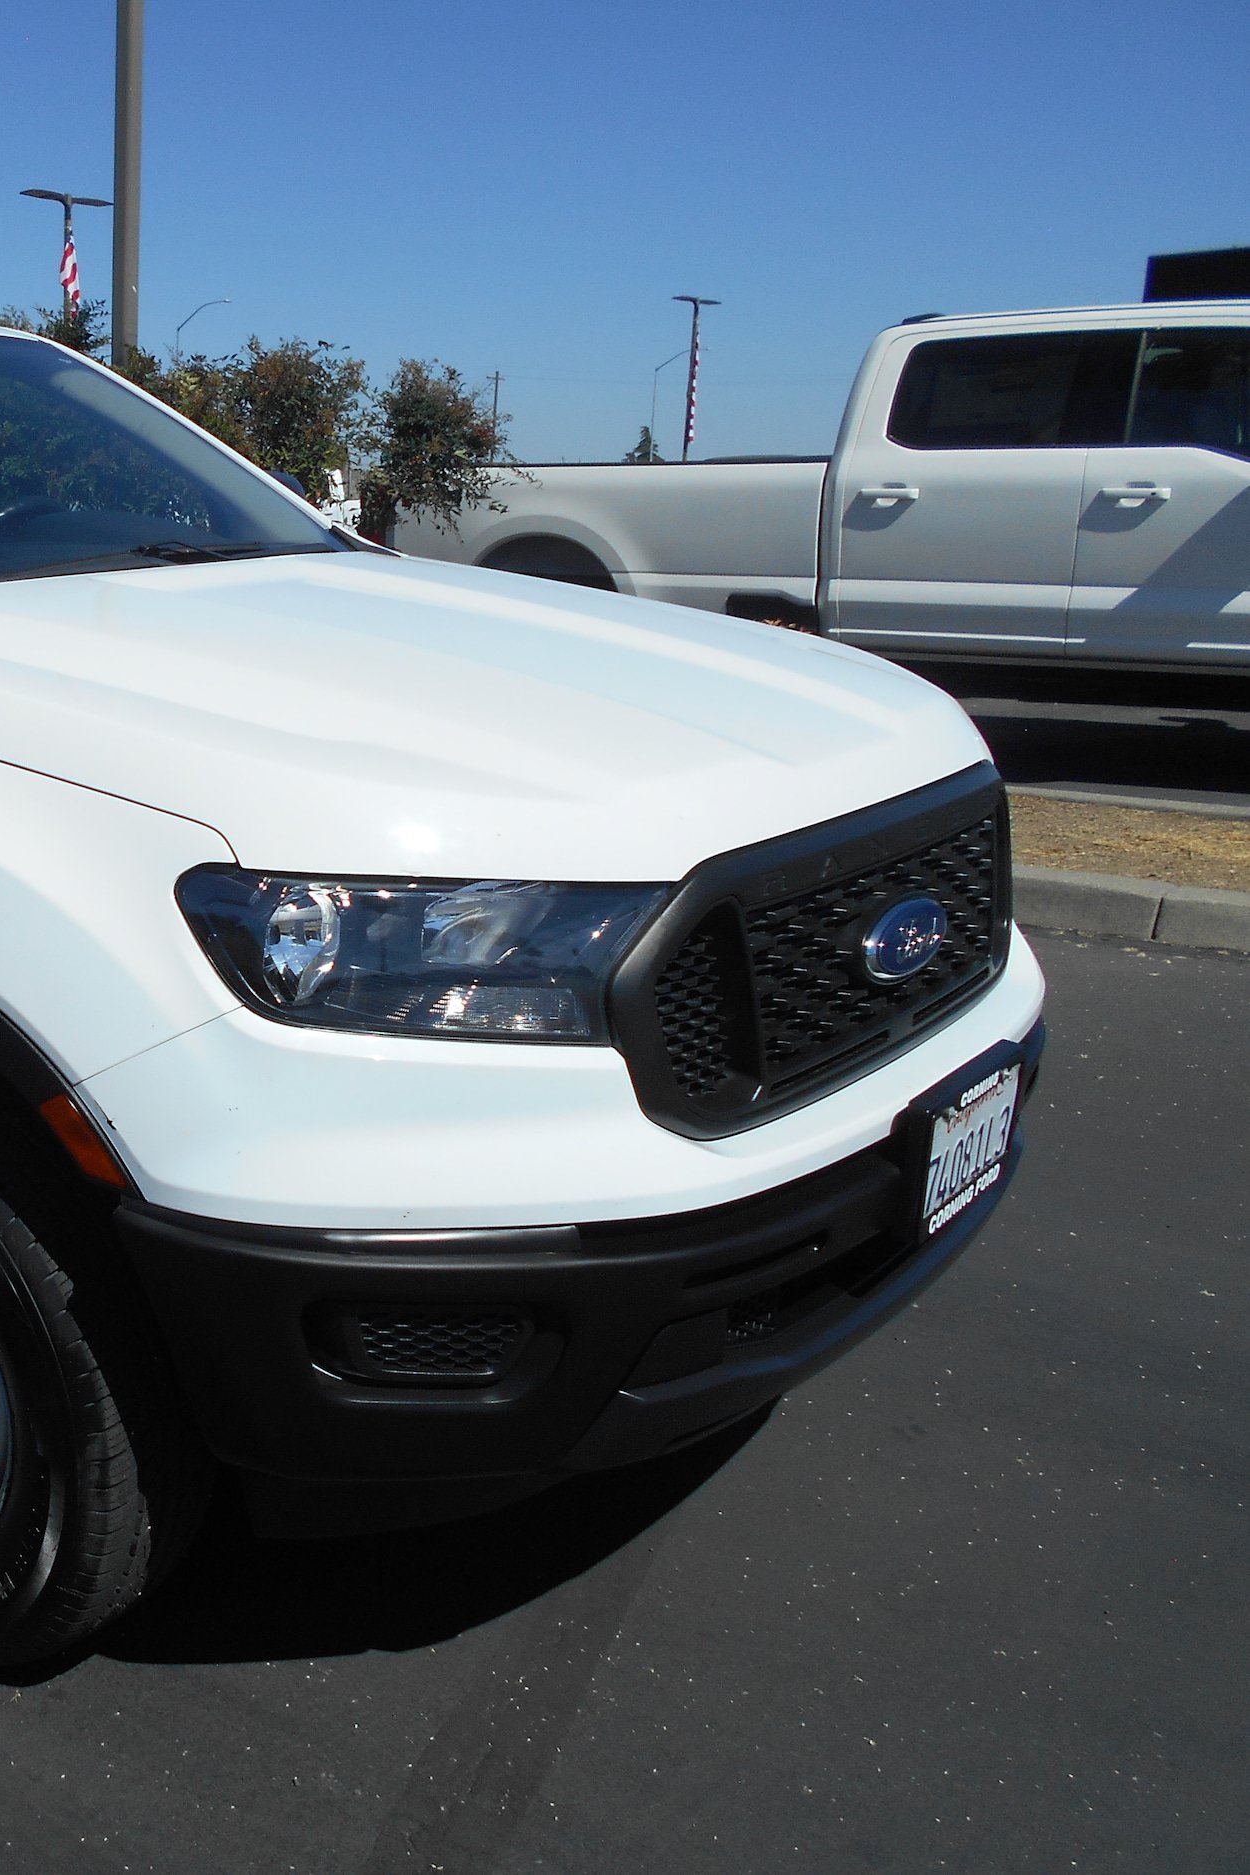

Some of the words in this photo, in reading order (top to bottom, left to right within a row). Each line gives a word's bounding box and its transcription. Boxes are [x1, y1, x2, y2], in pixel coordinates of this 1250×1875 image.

[960, 1070, 1000, 1108] CORNING
[925, 1105, 1011, 1214] 74081L3
[928, 1184, 975, 1234] CORNING
[973, 1162, 1001, 1197] FORD
